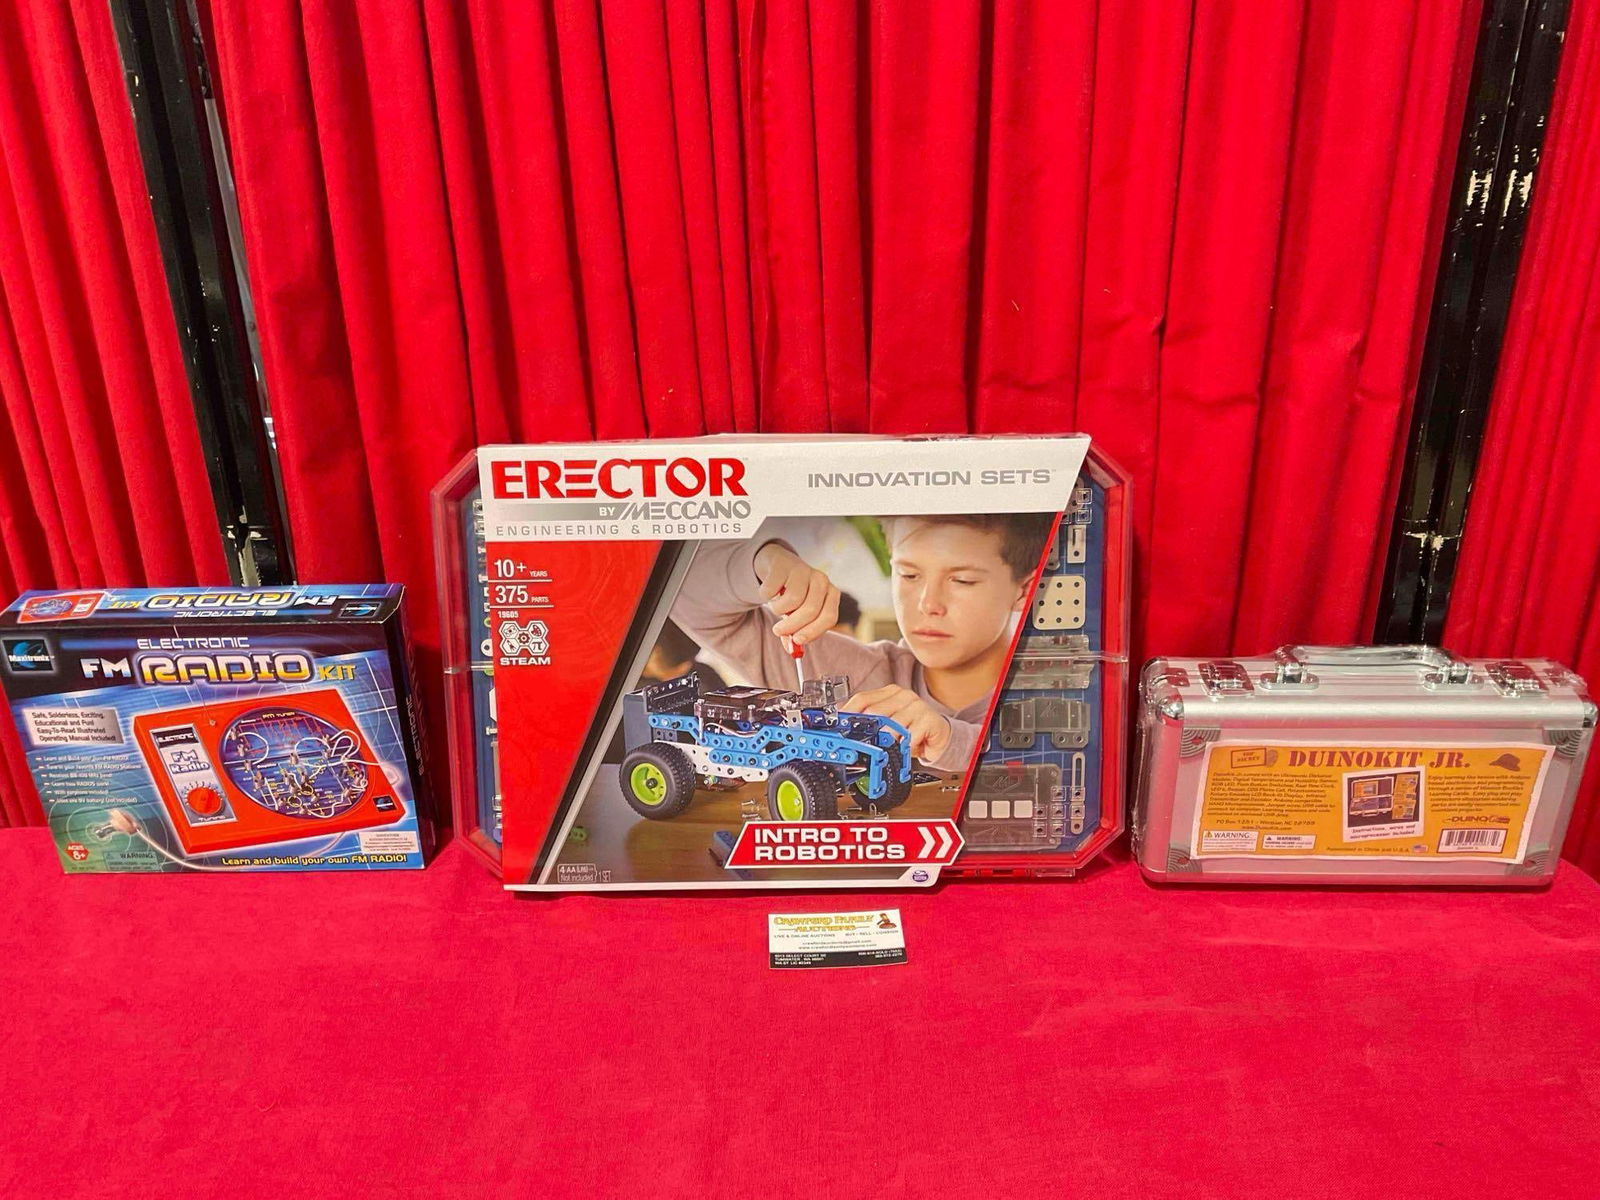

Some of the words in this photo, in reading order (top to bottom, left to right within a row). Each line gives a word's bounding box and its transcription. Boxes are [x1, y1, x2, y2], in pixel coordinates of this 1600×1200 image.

[491, 457, 749, 499] ERECTOR
[808, 471, 970, 488] INNOVATION
[980, 469, 1051, 484] SETS
[599, 507, 616, 516] BY
[619, 500, 751, 520] MECCANO
[496, 525, 620, 536] ENGINEERING
[632, 525, 641, 534] &
[653, 523, 742, 534] ROBOTICS
[494, 559, 527, 578] 10+
[148, 591, 295, 609] RADIO
[294, 596, 336, 606] FM
[495, 585, 529, 604] 375
[137, 637, 250, 650] ELECTRONIC
[81, 657, 132, 678] FM
[140, 652, 311, 684] RADIO
[318, 664, 356, 681] KIT
[500, 657, 551, 666] STEAM
[81, 711, 105, 719] Exciting,
[172, 750, 198, 762] FM
[1288, 751, 1422, 768] DUINOKIT
[1429, 752, 1471, 768] JR.
[170, 762, 211, 774] Radio
[754, 828, 841, 844] INTRO
[850, 827, 888, 842] TO
[73, 850, 86, 860] 8+
[253, 857, 272, 865] and
[274, 856, 299, 865] build
[302, 857, 325, 866] your
[351, 855, 368, 863] FM
[370, 854, 407, 863] RADIO!
[754, 844, 906, 861] ROBOTICS
